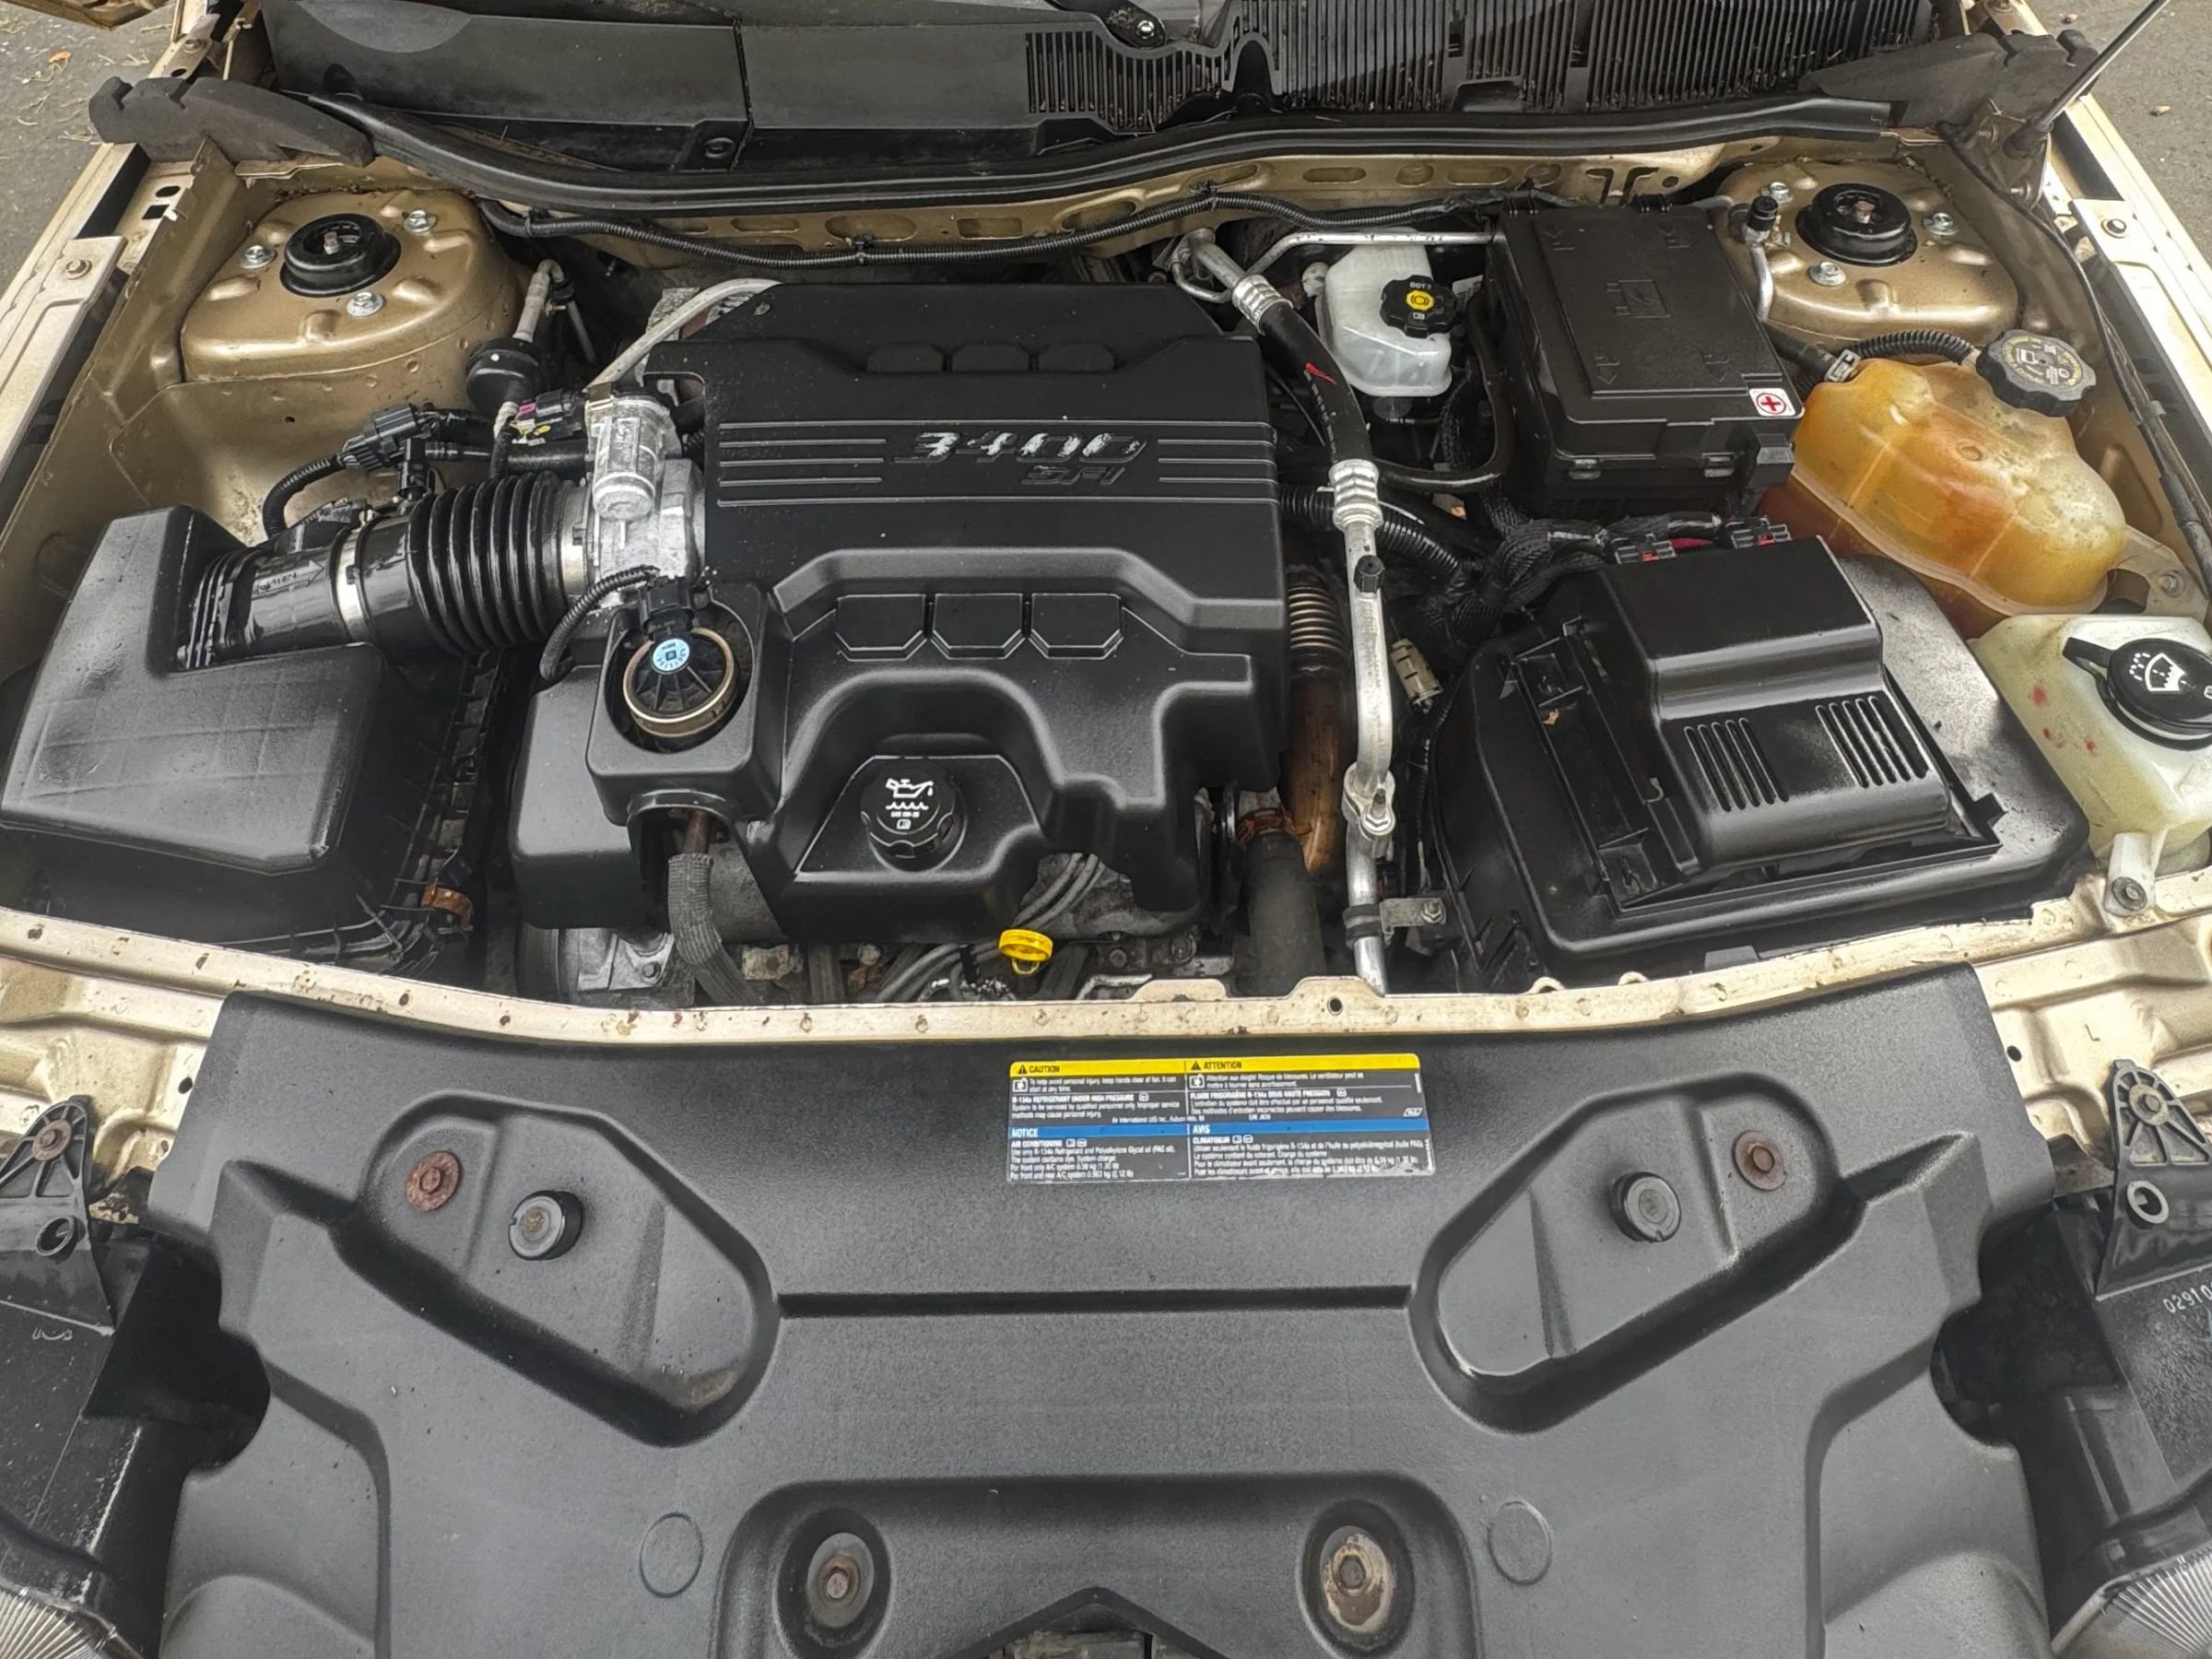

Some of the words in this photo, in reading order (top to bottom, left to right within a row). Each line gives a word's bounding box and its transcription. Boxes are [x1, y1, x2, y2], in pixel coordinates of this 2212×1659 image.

[894, 432, 1147, 463] 3400
[1029, 1065, 1061, 1074] CAUTION
[1204, 1061, 1242, 1070] ATTENTION
[1012, 1128, 1039, 1138] NOTICE
[1193, 1124, 1210, 1135] AVIS
[2162, 1281, 2212, 1313] 02910
